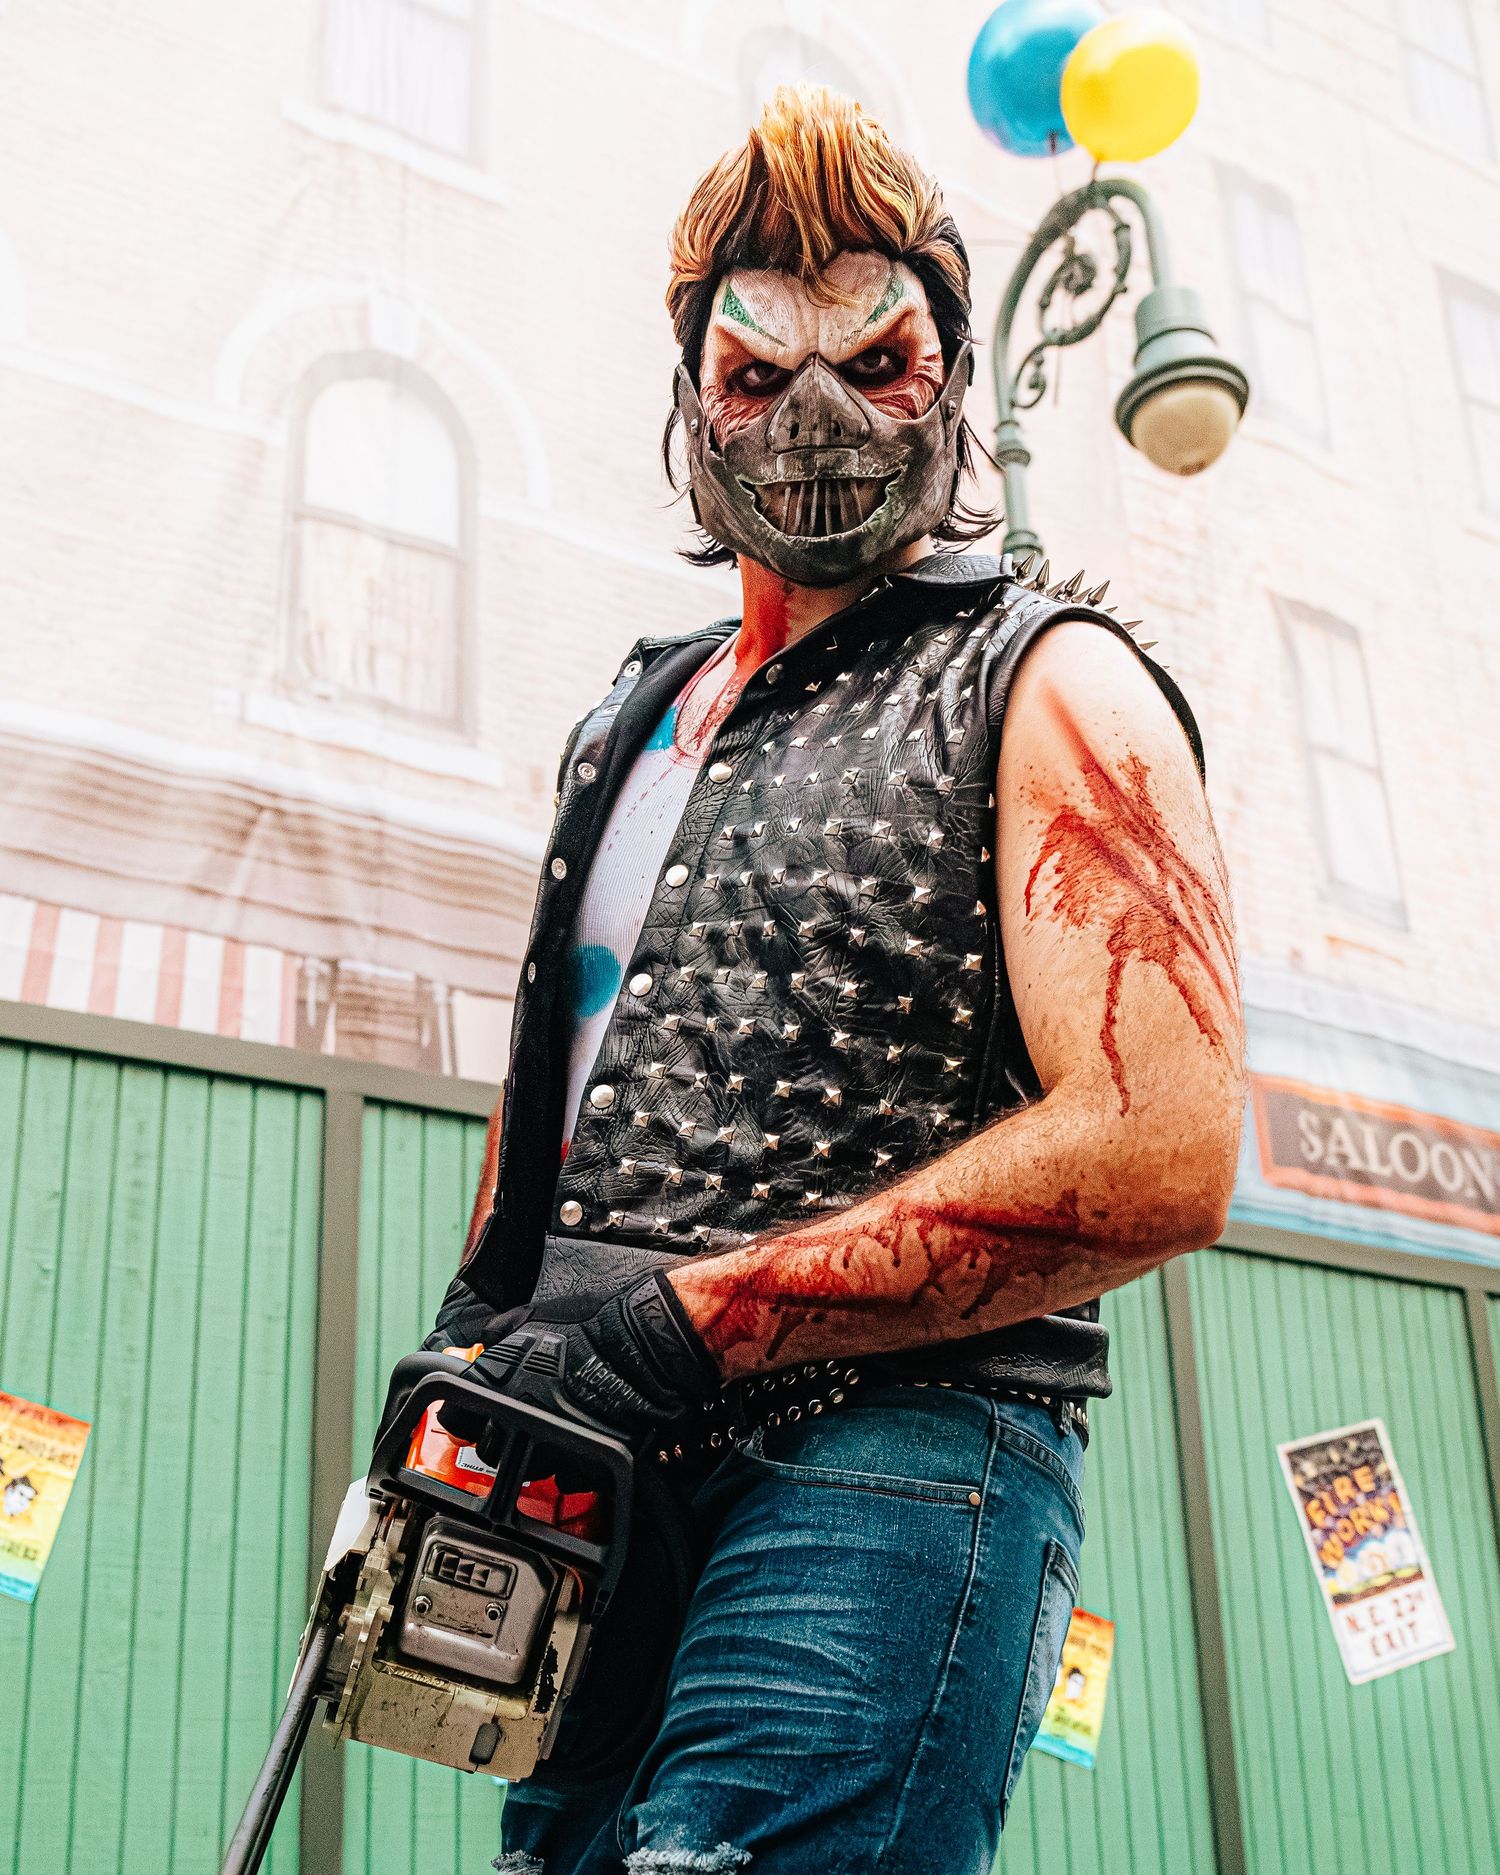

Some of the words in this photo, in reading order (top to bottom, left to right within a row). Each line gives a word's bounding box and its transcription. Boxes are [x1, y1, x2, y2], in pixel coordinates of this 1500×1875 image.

[1297, 1109, 1499, 1202] SALOON
[461, 1462, 484, 1472] STIHL
[1304, 1465, 1376, 1528] FIRE
